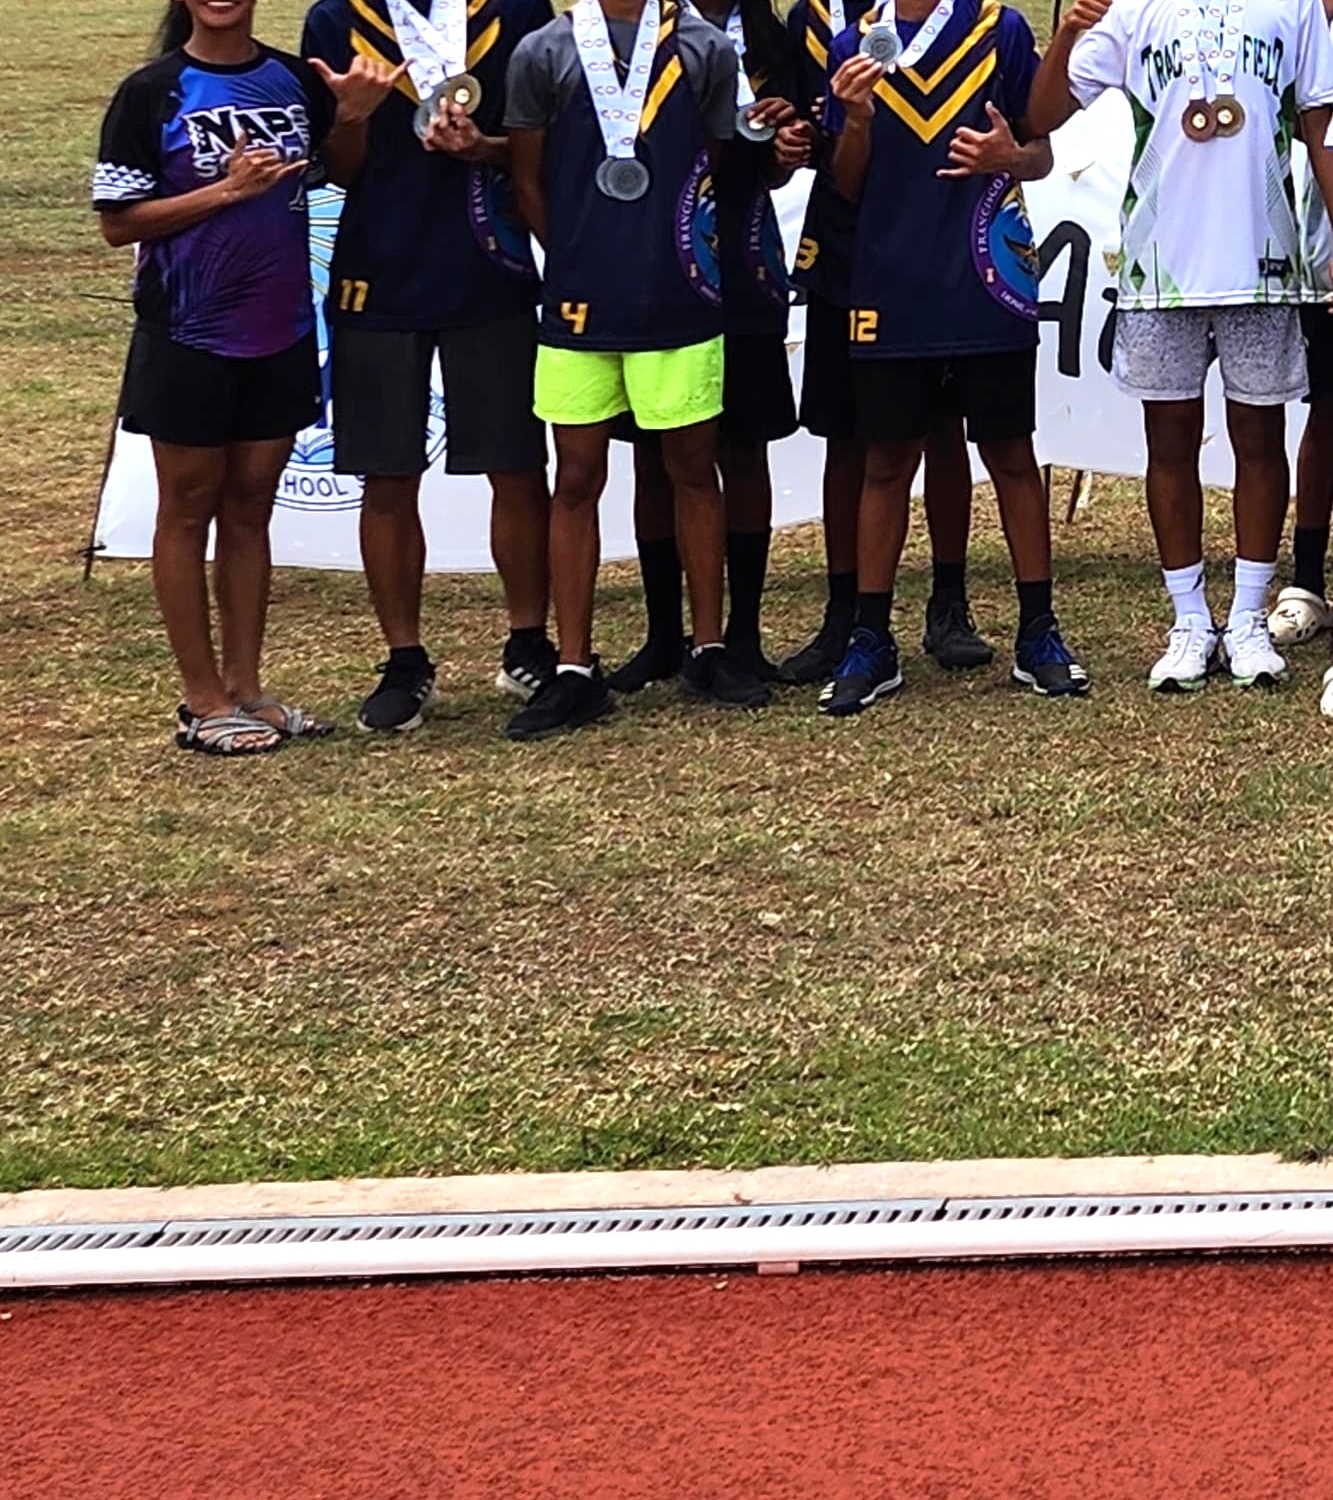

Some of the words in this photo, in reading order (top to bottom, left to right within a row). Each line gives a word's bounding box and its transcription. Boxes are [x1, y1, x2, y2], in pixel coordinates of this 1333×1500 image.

[1141, 38, 1184, 103] TRAC
[1242, 34, 1284, 97] FIELD
[339, 278, 369, 312] 11
[560, 301, 589, 335] 4
[849, 309, 879, 342] 12
